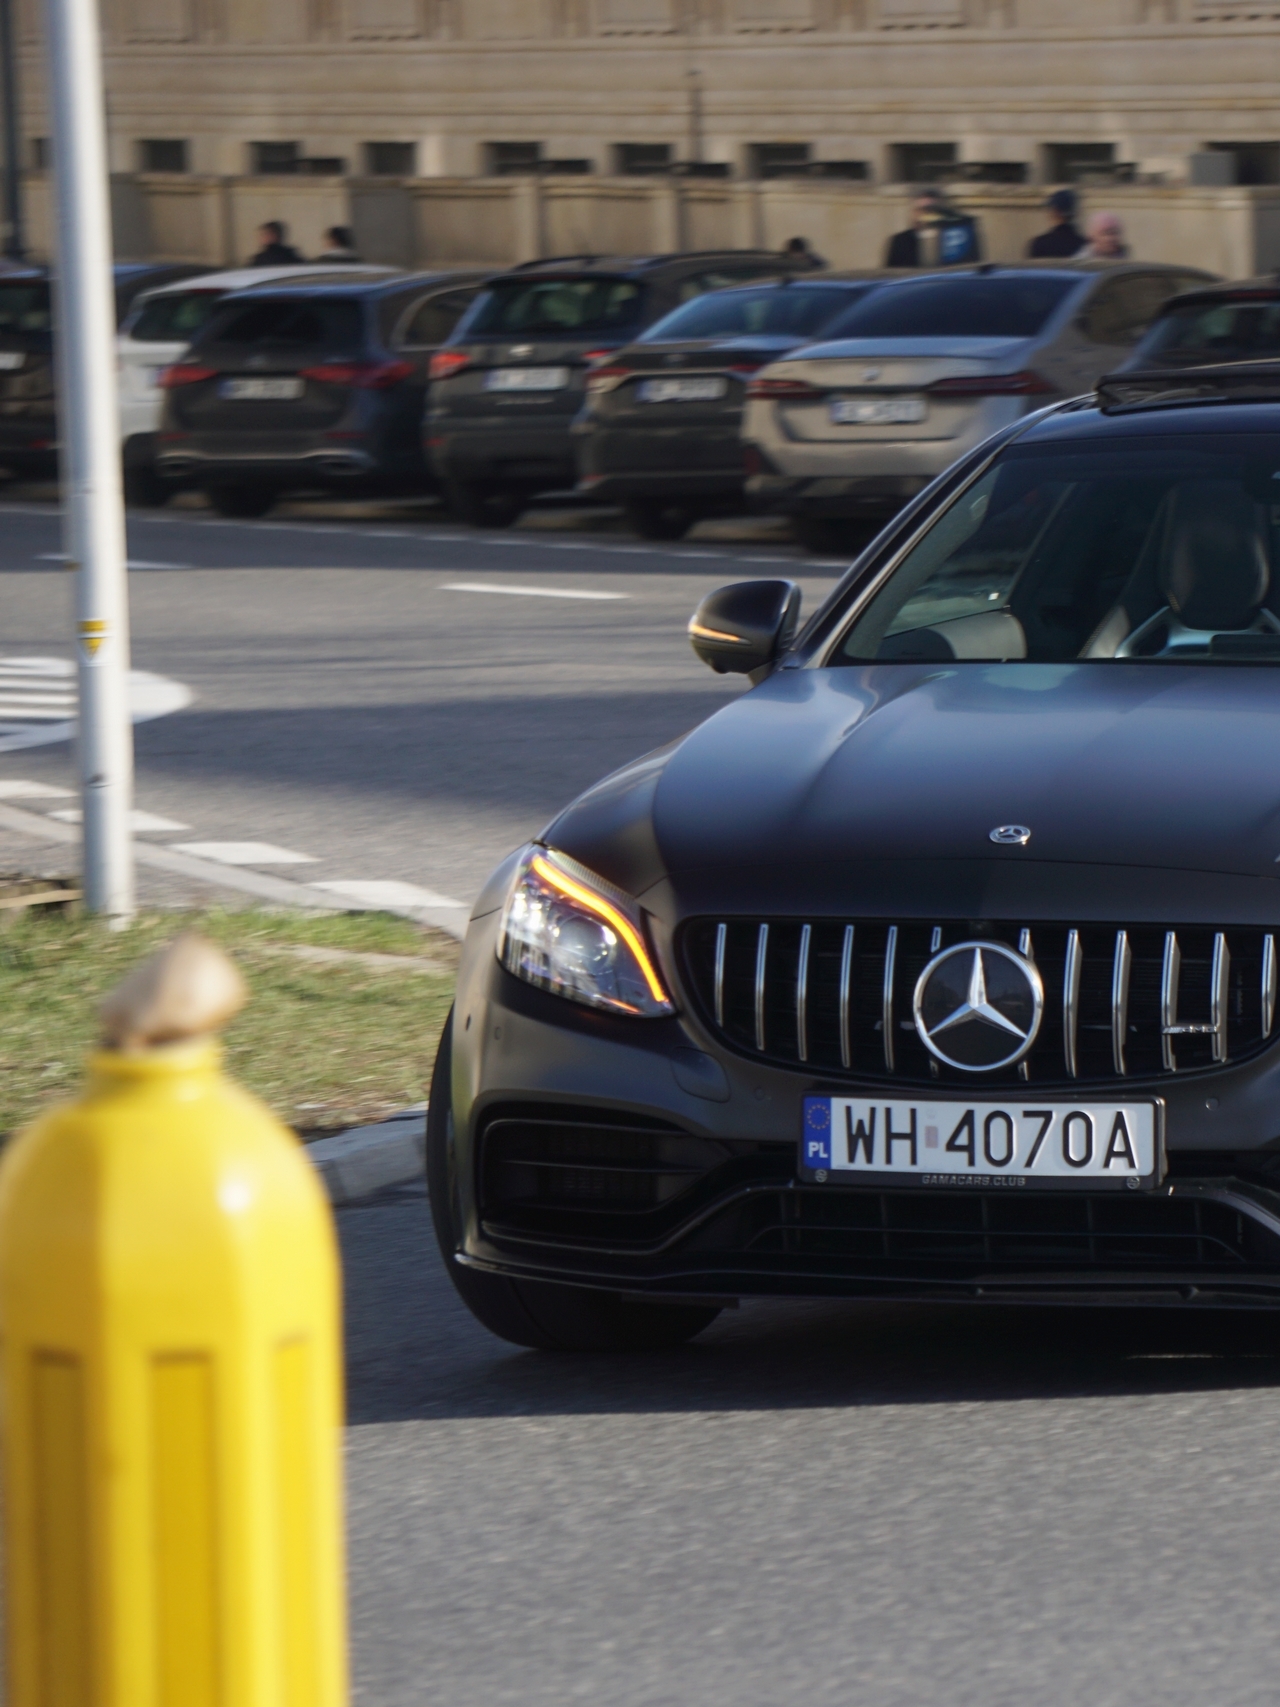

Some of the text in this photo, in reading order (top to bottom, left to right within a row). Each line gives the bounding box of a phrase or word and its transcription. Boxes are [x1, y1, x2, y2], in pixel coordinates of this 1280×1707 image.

[844, 1105, 1138, 1169] WH 4070A
[808, 1141, 828, 1159] PL
[922, 1175, 1026, 1187] GAMACARS.CLUB
